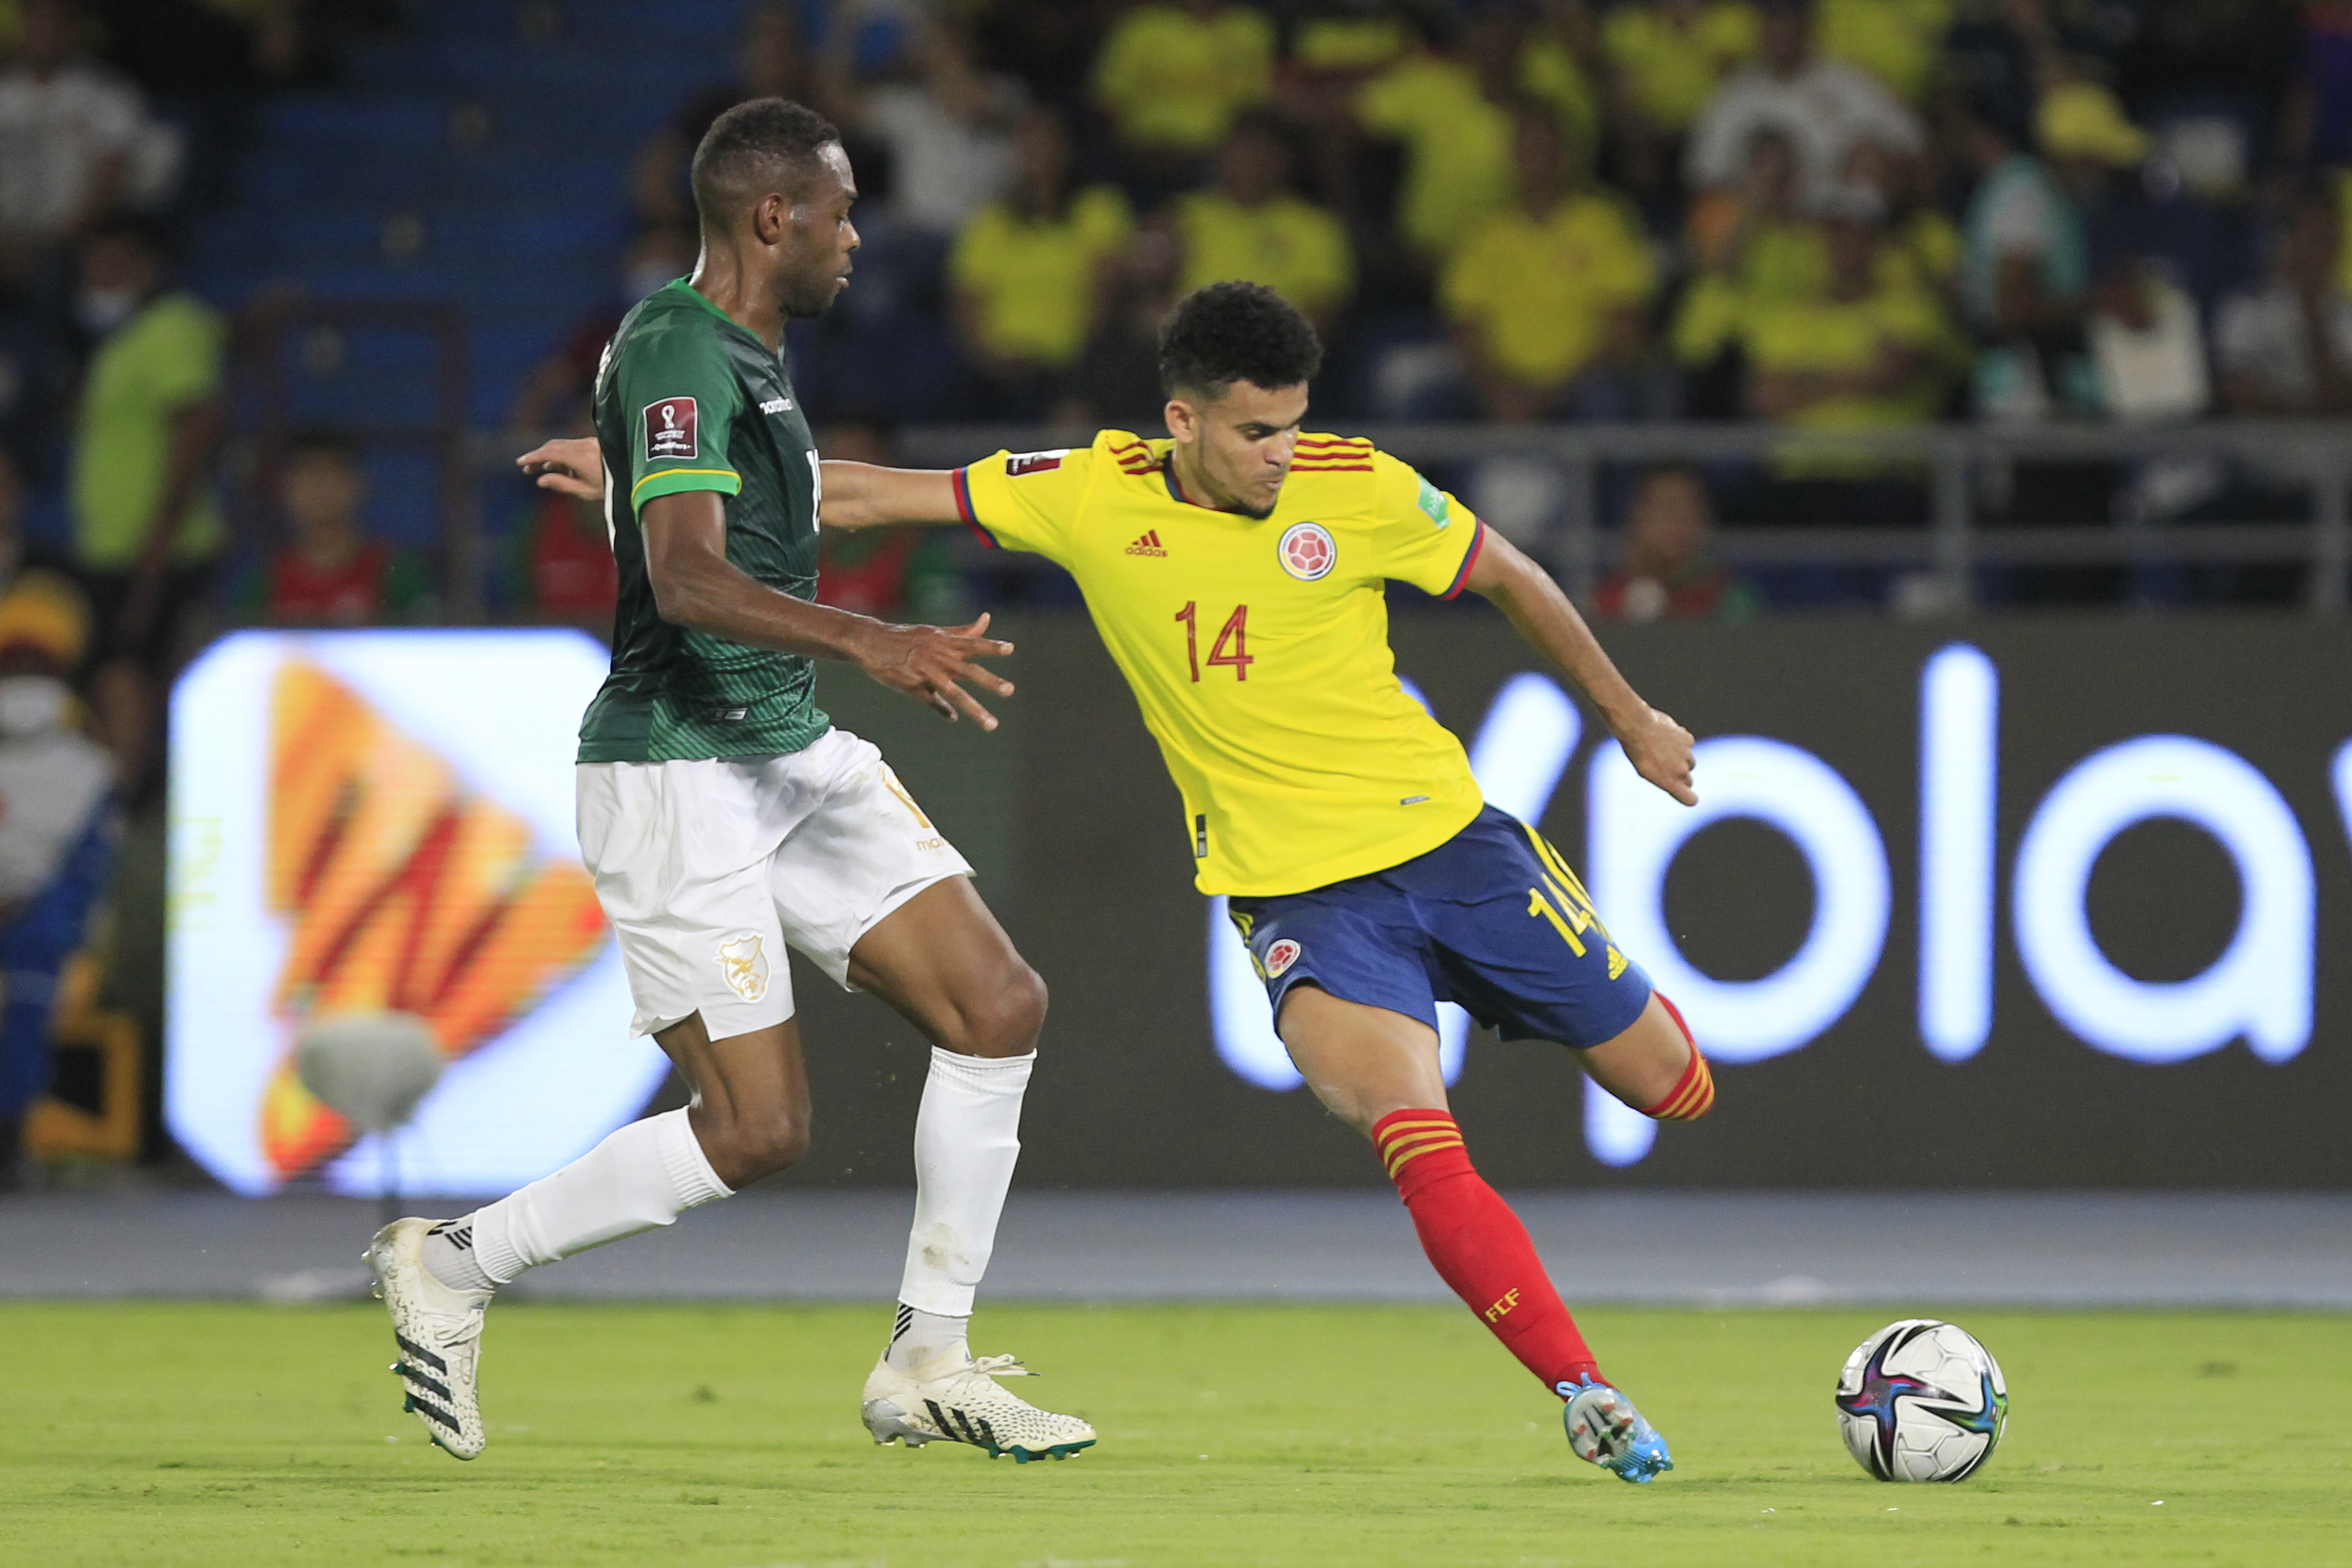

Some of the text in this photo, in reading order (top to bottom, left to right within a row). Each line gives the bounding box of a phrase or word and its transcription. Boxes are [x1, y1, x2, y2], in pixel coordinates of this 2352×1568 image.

[805, 448, 822, 534] 1
[1126, 547, 1168, 558] adidas
[1175, 601, 1253, 682] 14
[879, 768, 931, 828] 1
[916, 837, 950, 851] mar
[1207, 641, 2352, 1168] pla
[1527, 872, 1601, 958] 14
[1485, 1287, 1520, 1323] FCF
